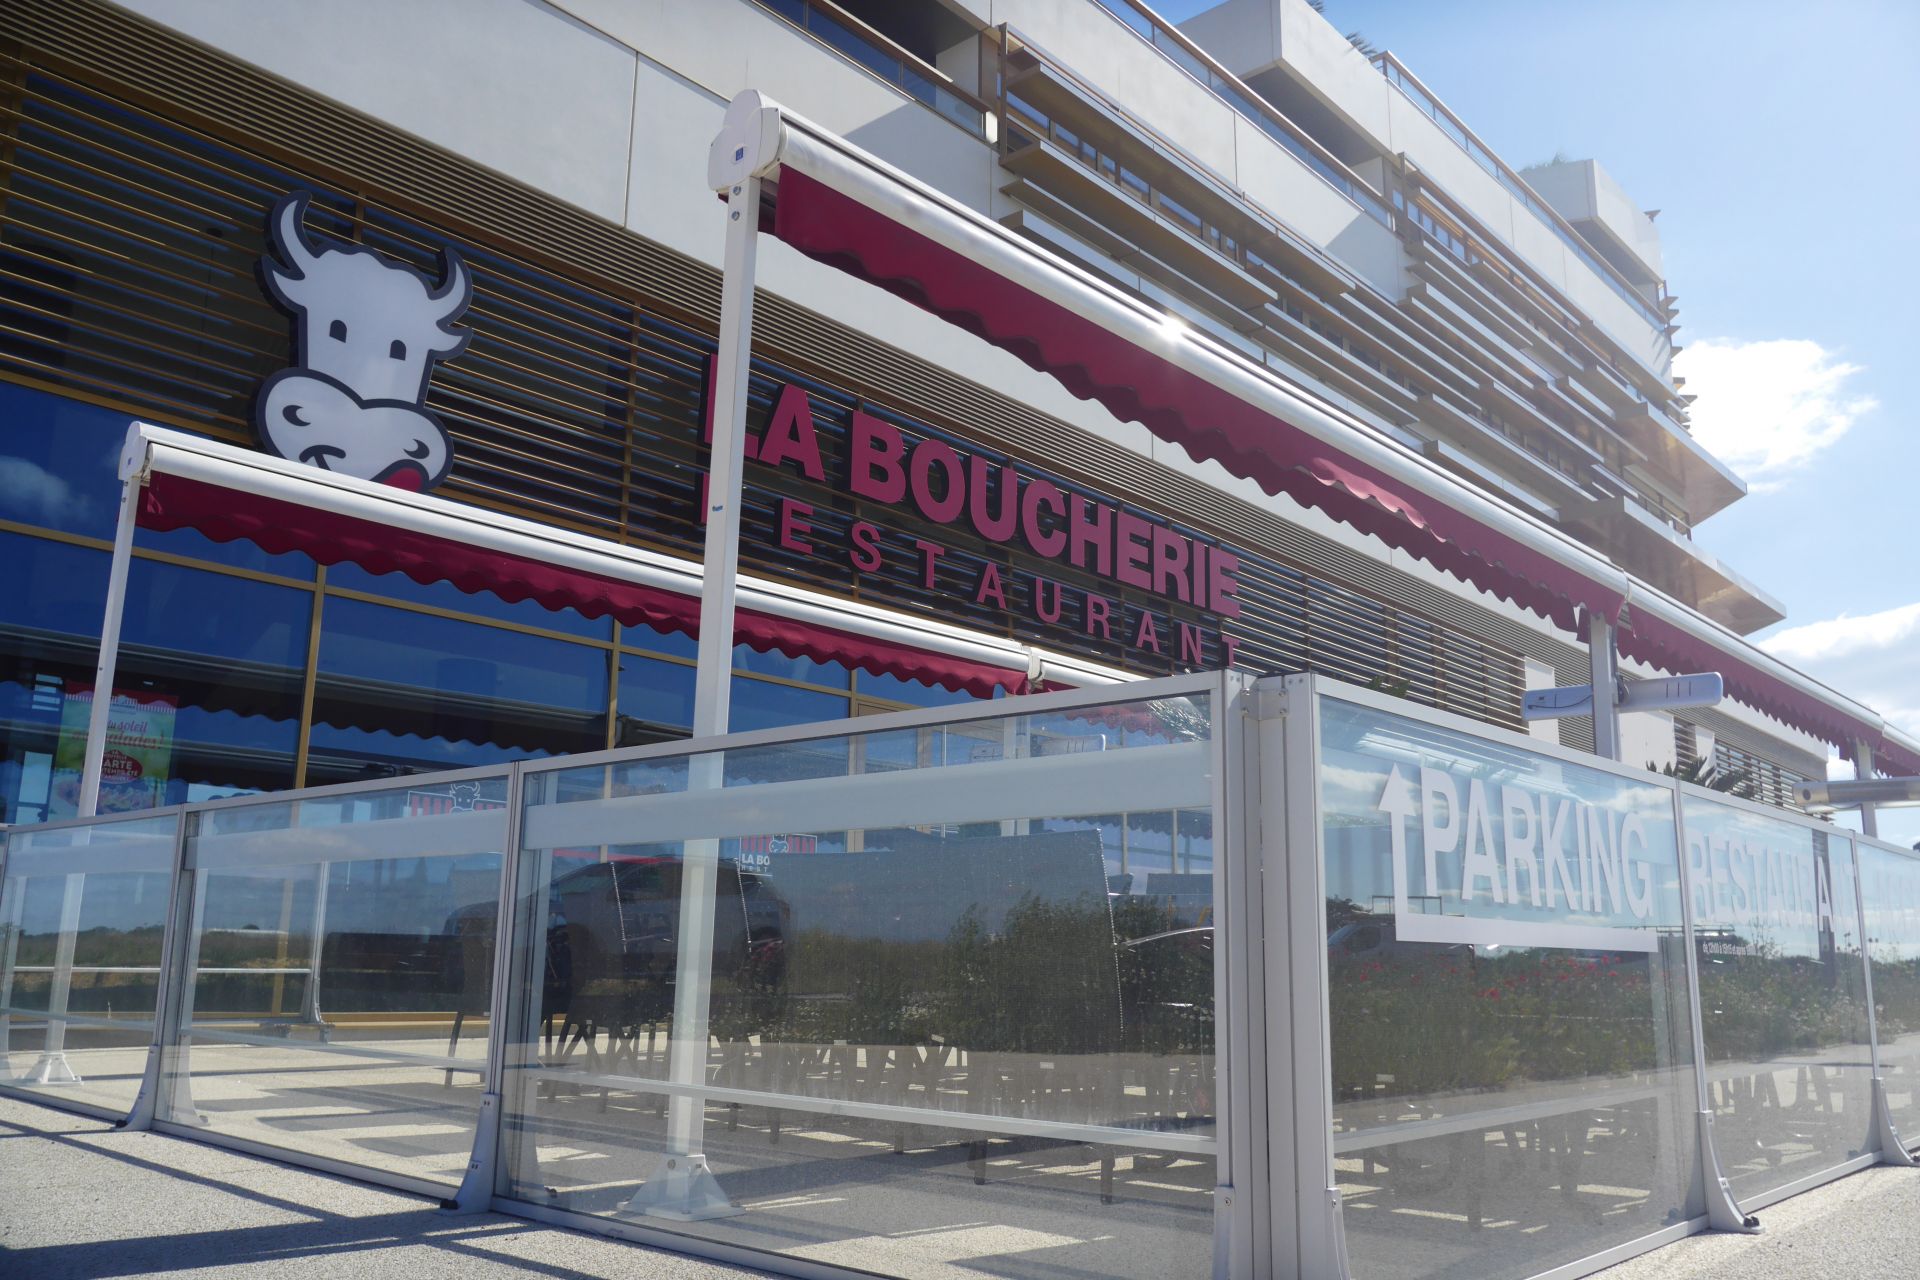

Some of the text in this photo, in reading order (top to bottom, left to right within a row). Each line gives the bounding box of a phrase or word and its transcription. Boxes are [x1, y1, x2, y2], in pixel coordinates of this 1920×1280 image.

[704, 353, 1241, 619] LA BOUCHERIE
[701, 472, 1241, 667] ESTAURANT
[103, 759, 133, 770] ARTE
[741, 853, 755, 865] LA
[1420, 766, 1654, 920] PARKING
